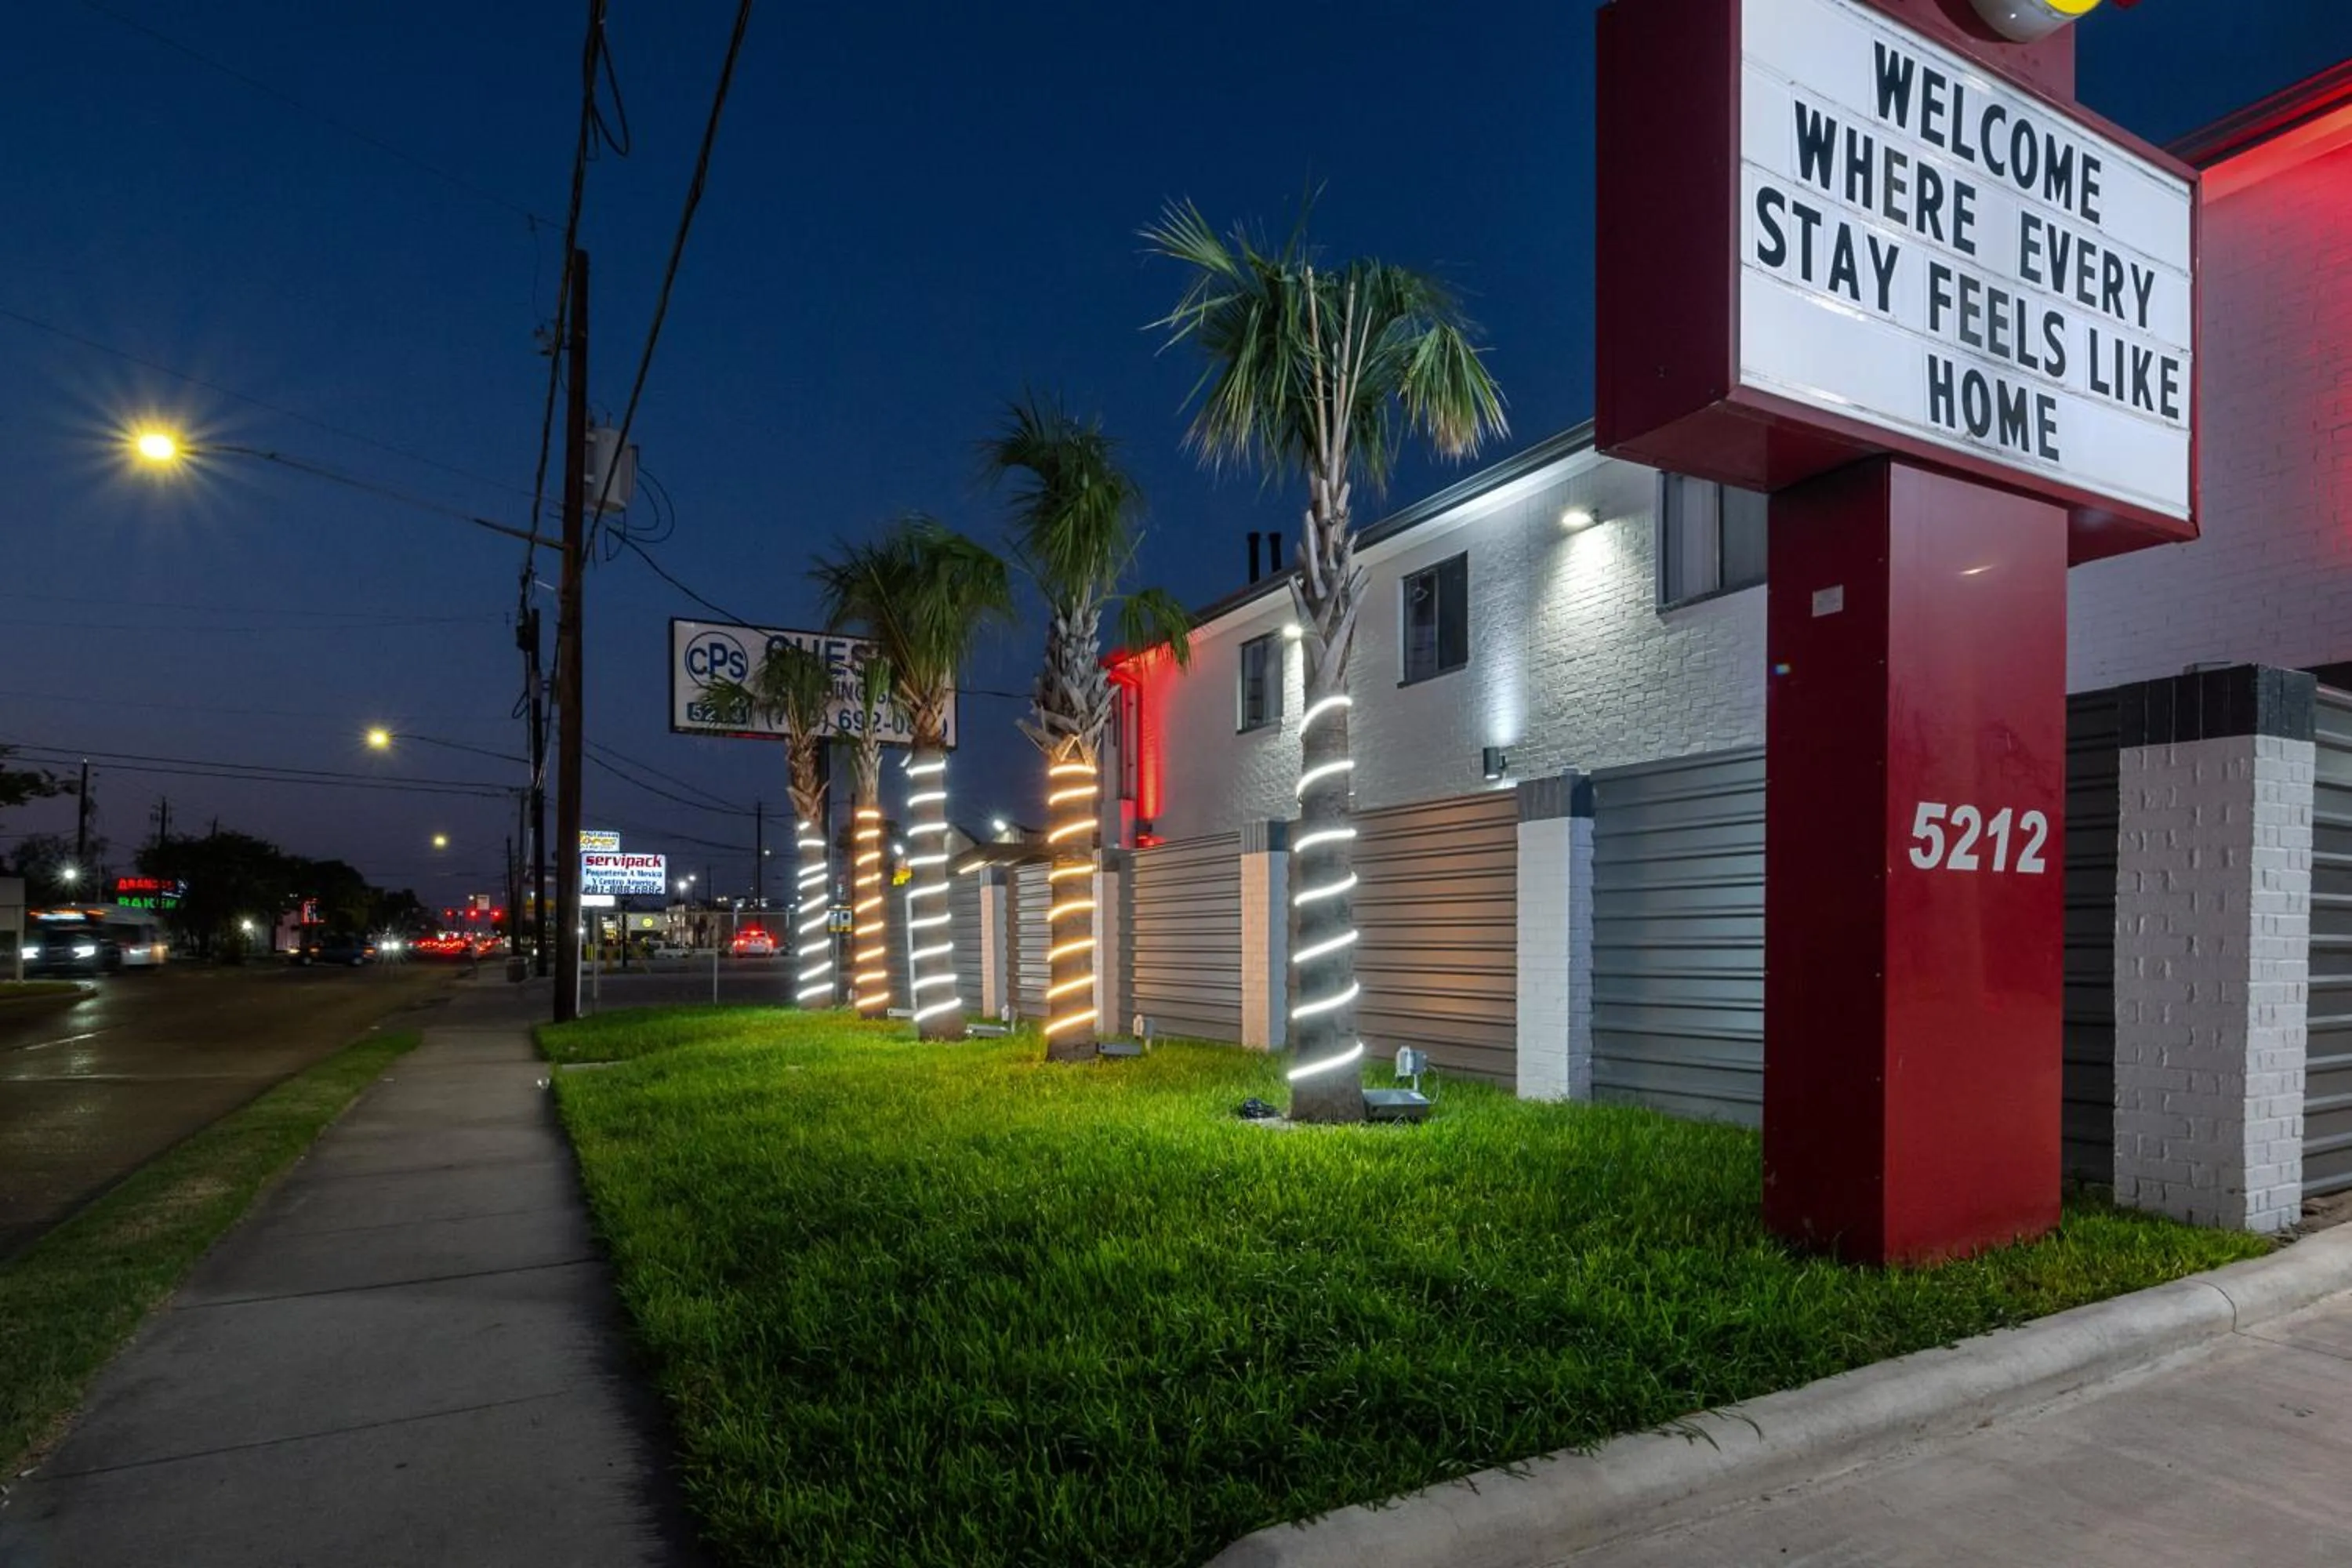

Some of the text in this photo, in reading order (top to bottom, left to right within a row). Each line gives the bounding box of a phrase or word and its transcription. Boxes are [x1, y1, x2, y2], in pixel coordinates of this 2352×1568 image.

[1875, 38, 2102, 225] WELCOME
[1795, 100, 2155, 329] WHERE EVERY
[1756, 186, 2179, 419] STAY FEELS LIKE
[1928, 354, 2060, 462] HOME
[688, 642, 746, 679] CPS
[586, 854, 662, 869] servipack
[1909, 802, 2048, 874] 5212
